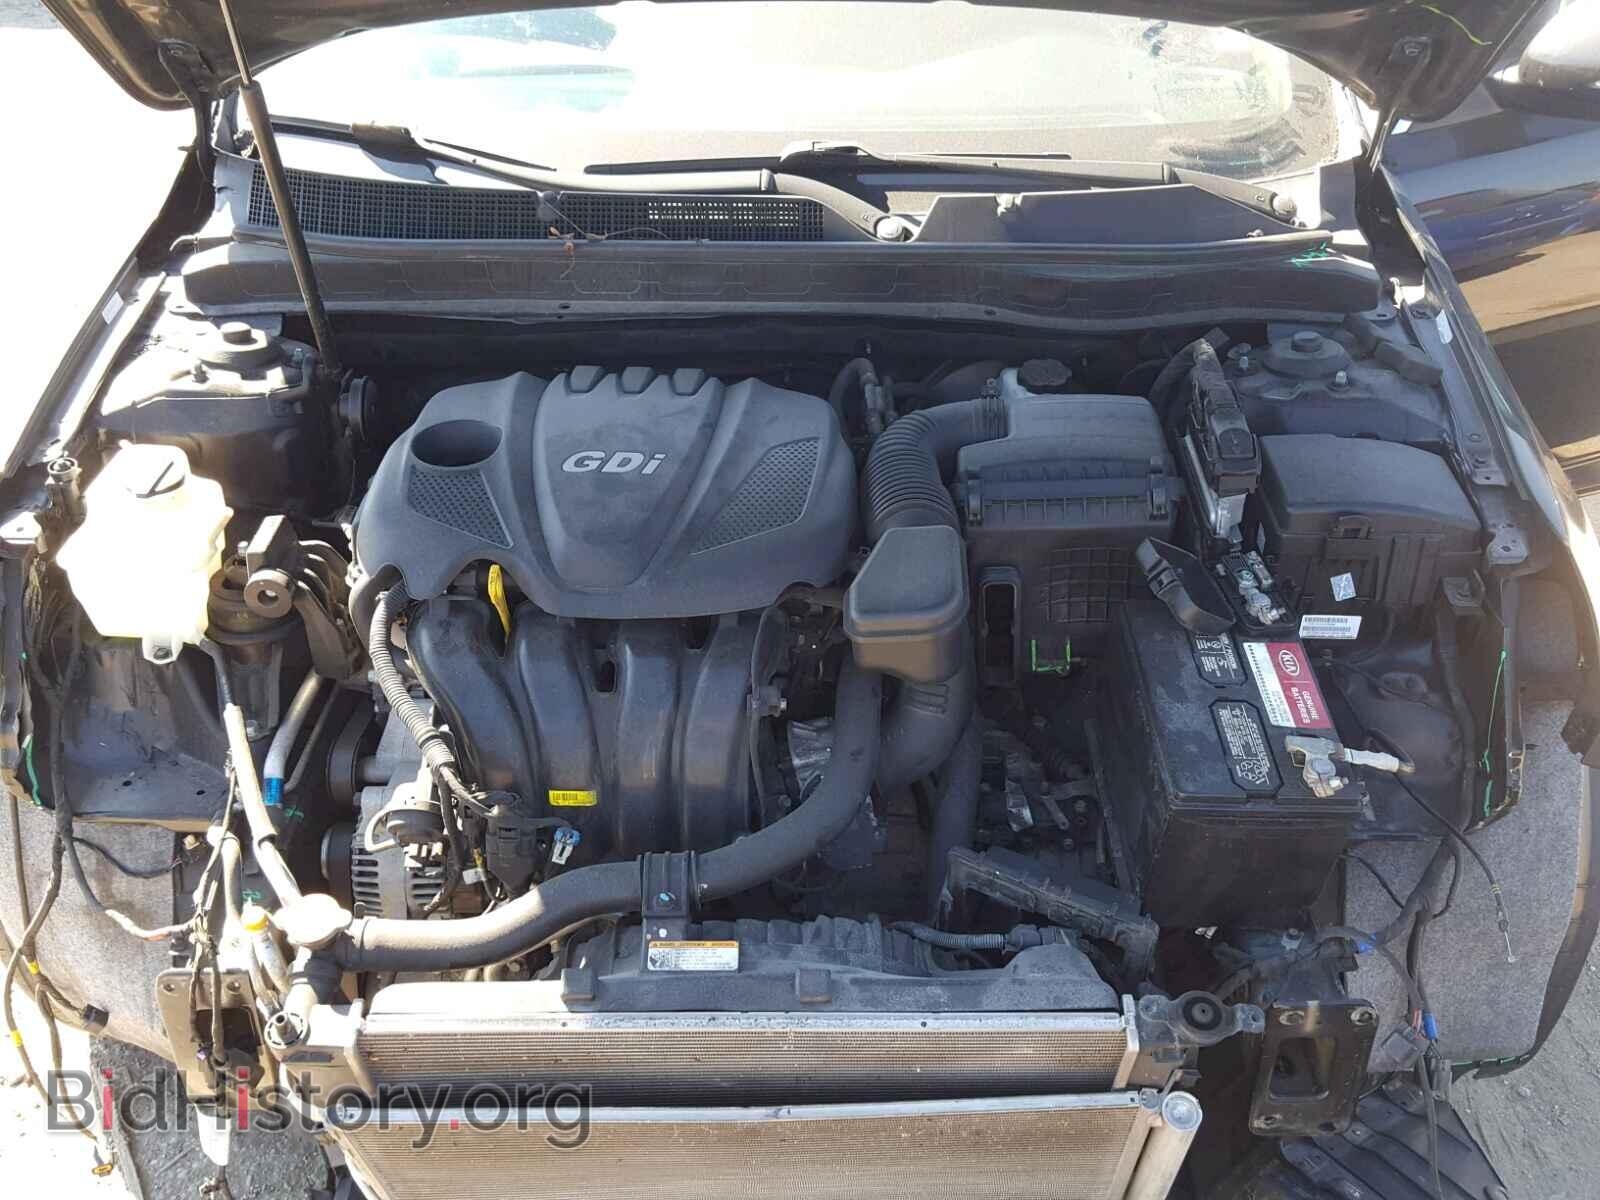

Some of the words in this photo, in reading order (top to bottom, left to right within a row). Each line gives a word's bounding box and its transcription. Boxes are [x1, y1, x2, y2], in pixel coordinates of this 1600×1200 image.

[561, 450, 666, 475] GDi
[1281, 653, 1298, 673] KIA
[1290, 686, 1311, 724] BATTERIES
[1302, 690, 1321, 720] GENUINE
